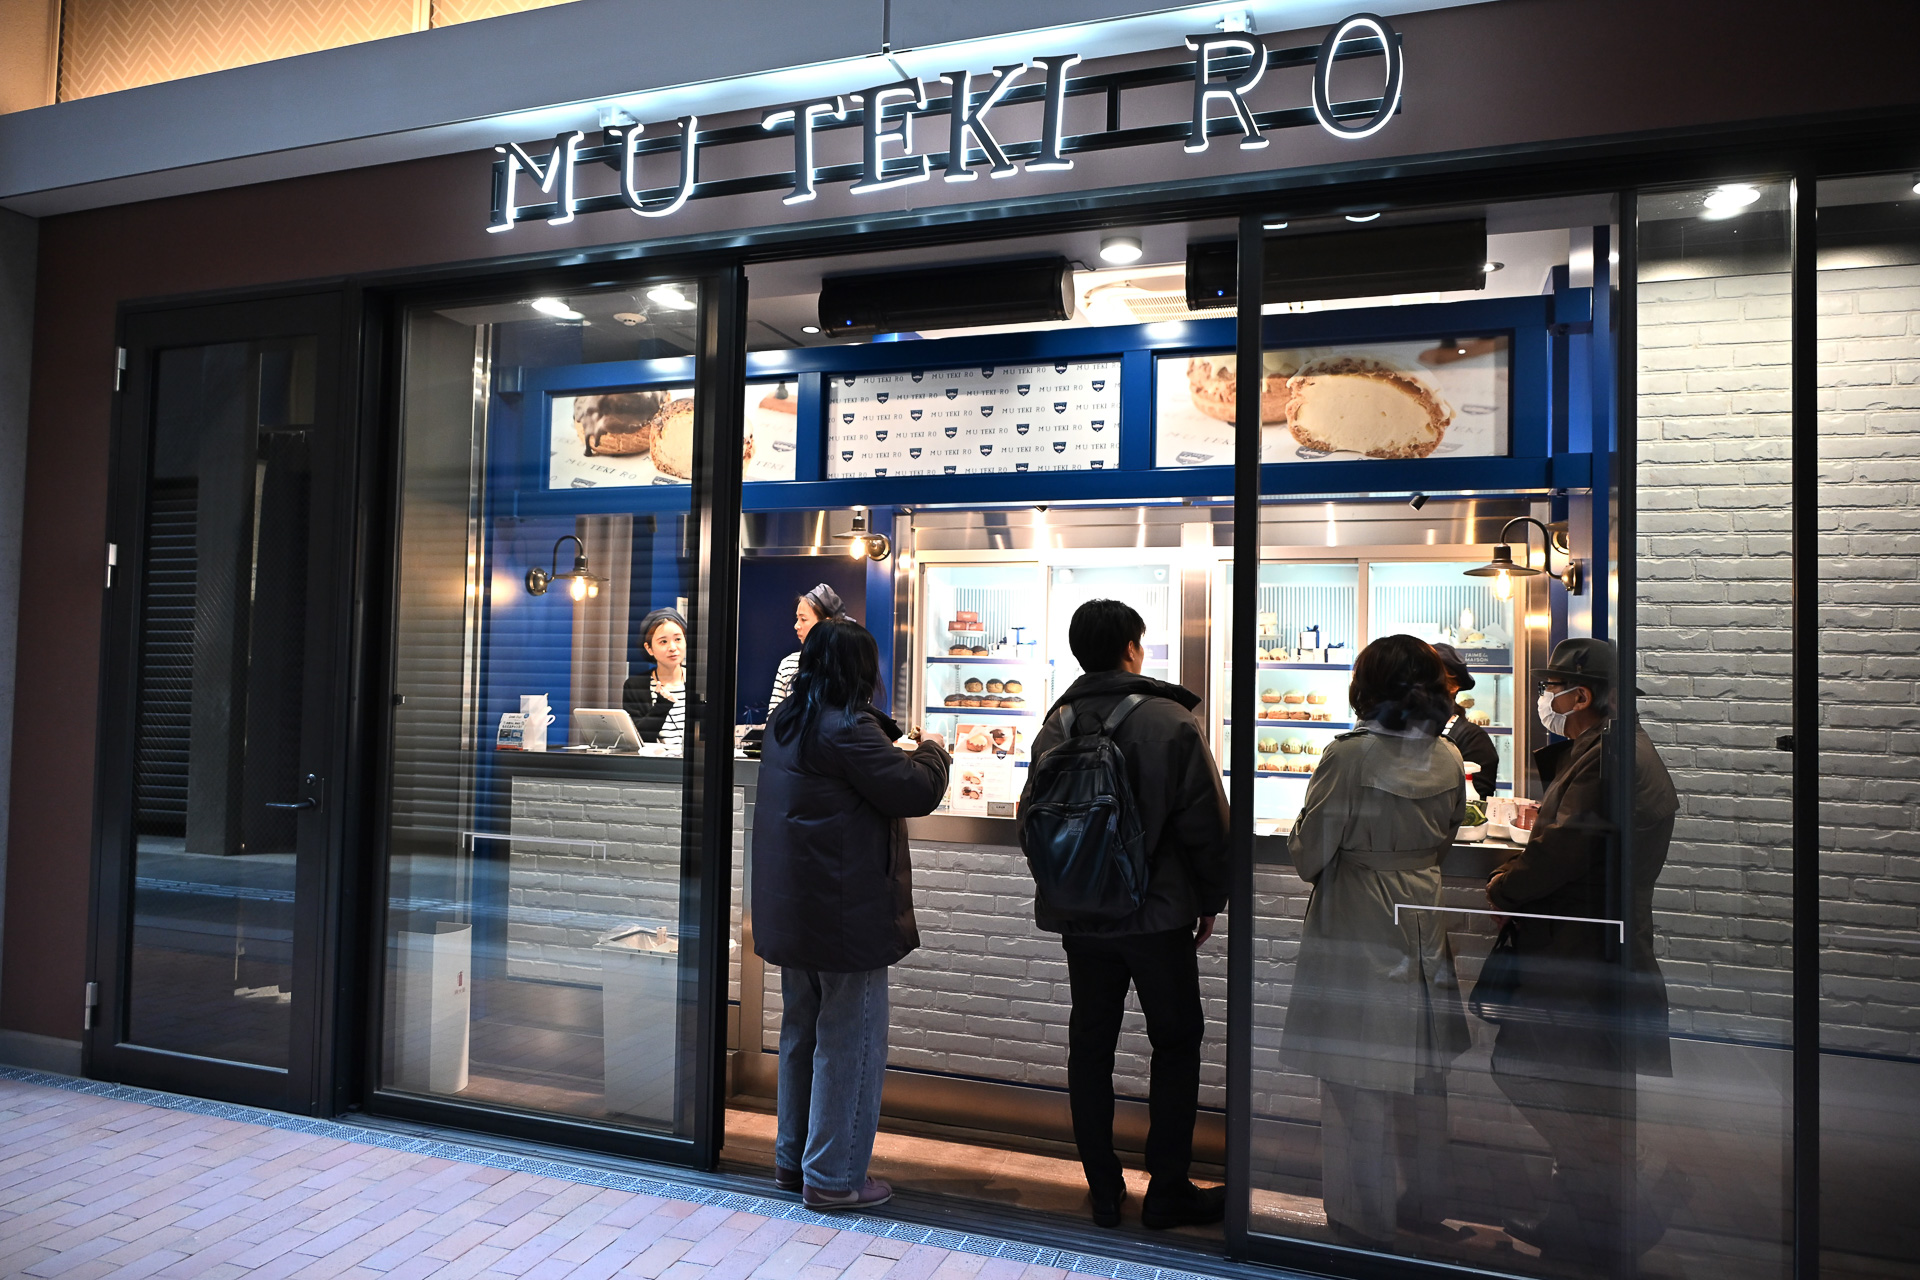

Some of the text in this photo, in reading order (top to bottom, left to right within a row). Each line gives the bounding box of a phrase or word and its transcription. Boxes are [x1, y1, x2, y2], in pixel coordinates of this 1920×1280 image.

[486, 12, 1404, 234] MU TEKI RO
[566, 458, 637, 480] MU TEKI RO
